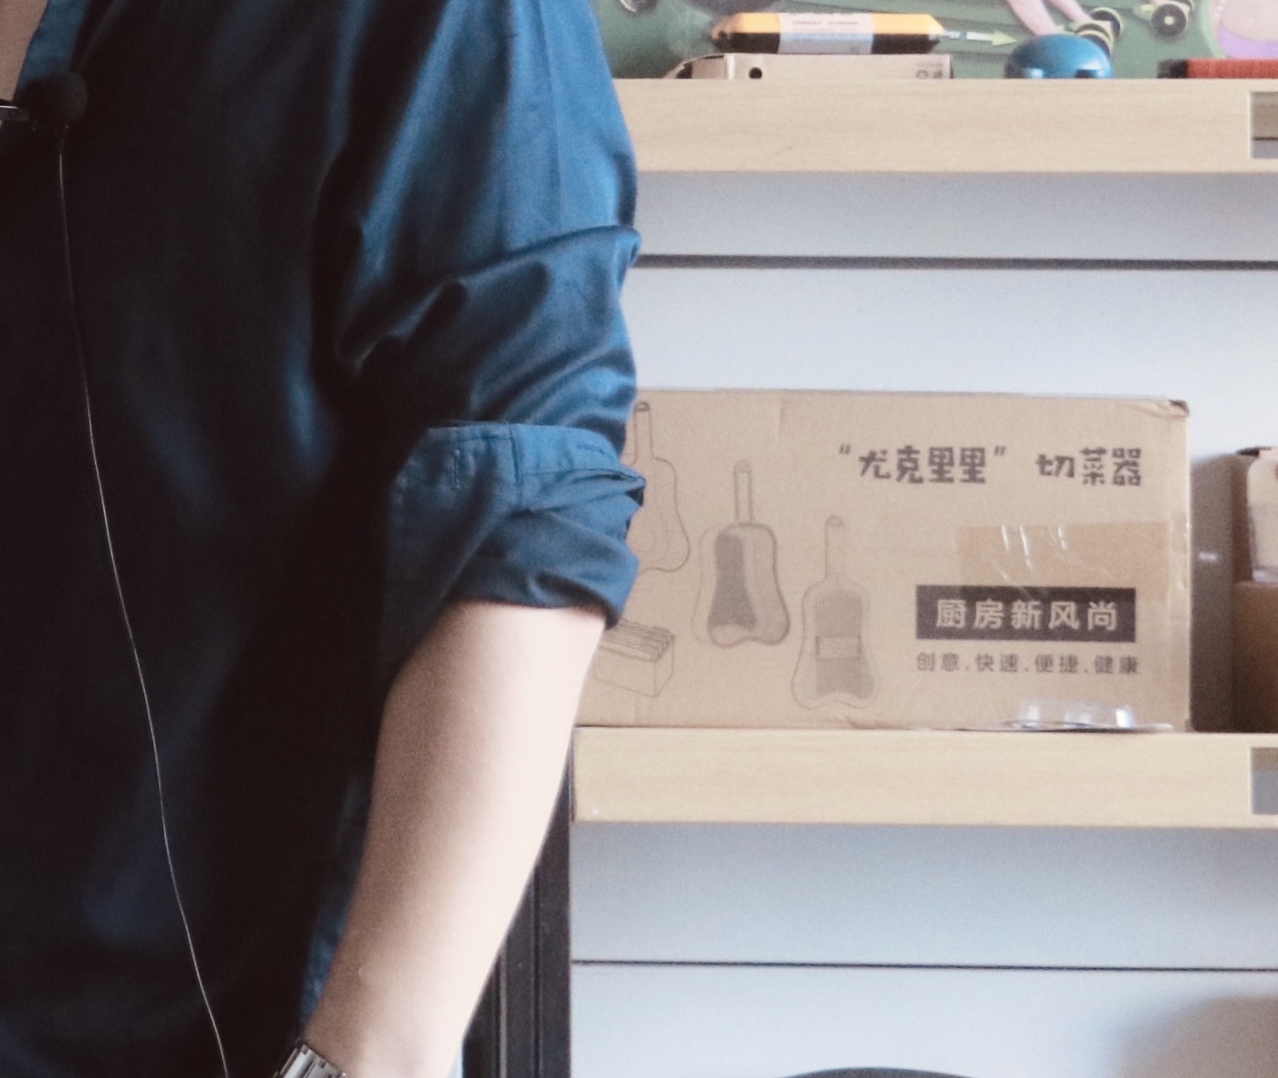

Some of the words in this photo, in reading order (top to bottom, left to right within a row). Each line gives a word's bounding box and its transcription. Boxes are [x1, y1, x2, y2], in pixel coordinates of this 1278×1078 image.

[1034, 446, 1142, 488] 切菜器
[935, 598, 1119, 632] 厨房新风尚
